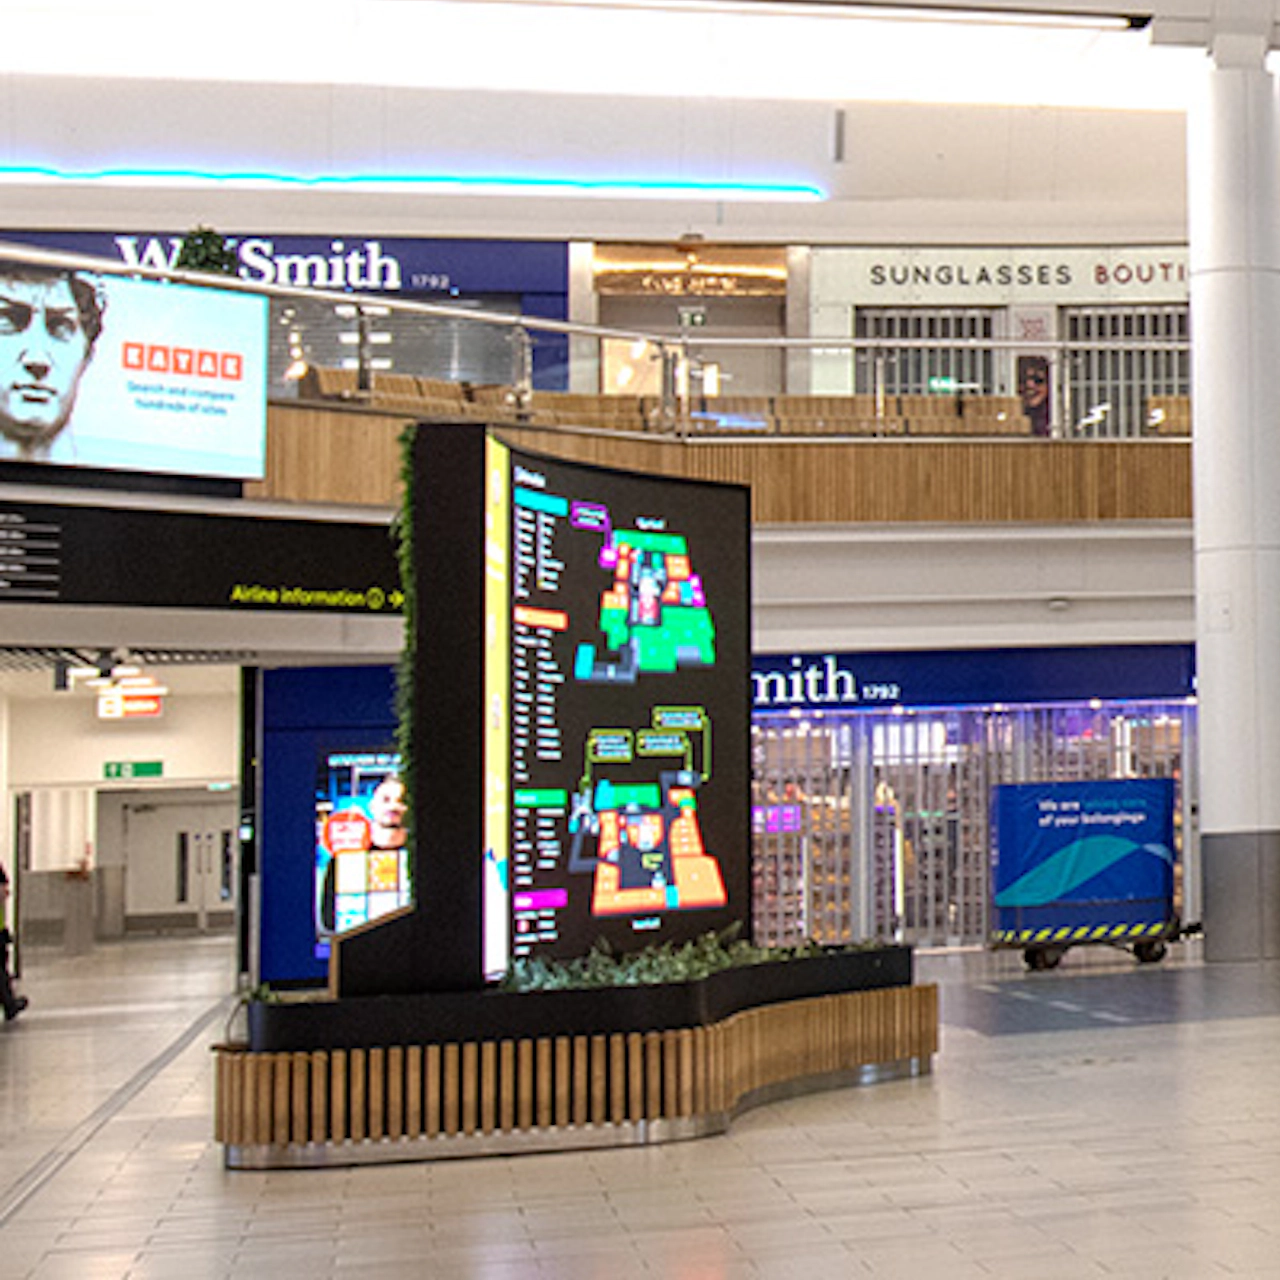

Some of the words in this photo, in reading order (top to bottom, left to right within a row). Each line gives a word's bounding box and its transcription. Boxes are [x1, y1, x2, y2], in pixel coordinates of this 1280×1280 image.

[871, 265, 1073, 286] SUNGLASSES
[1094, 263, 1187, 285] BOUTI
[124, 344, 240, 378] KAYAK
[230, 584, 279, 605] Airline
[280, 586, 367, 608] information
[751, 654, 858, 703] mith
